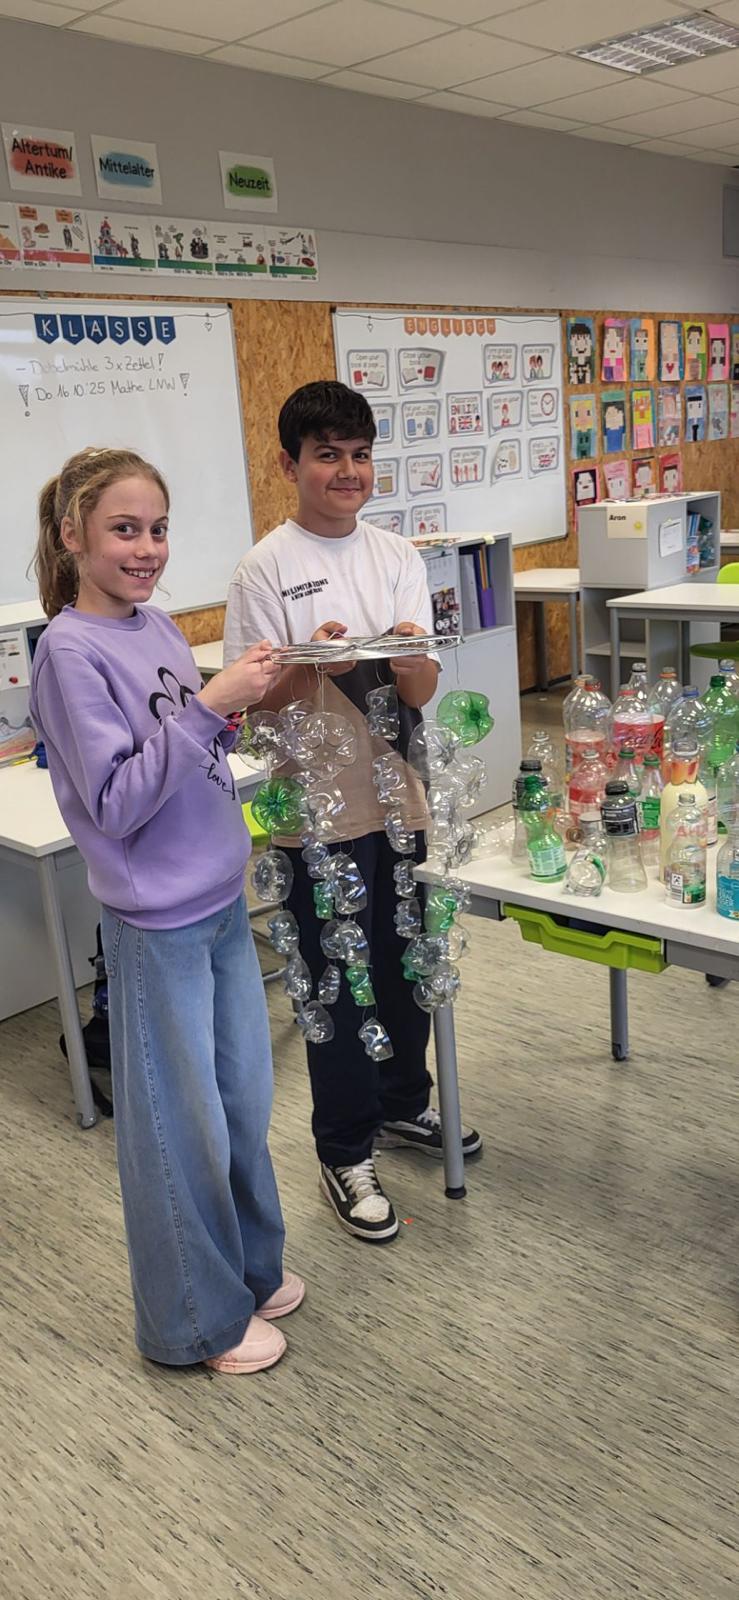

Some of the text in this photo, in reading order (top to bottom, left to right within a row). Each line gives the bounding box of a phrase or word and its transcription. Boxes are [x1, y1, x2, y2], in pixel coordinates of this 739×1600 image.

[12, 138, 73, 162] Altertum/
[25, 160, 67, 179] Antike
[99, 157, 155, 178] Mittelalter
[228, 172, 271, 191] Neuzeit
[41, 319, 171, 338] KLASSE
[406, 319, 495, 333] ENGLISCH
[35, 387, 53, 401] Do
[110, 379, 145, 396] Mathe
[199, 763, 232, 793] love
